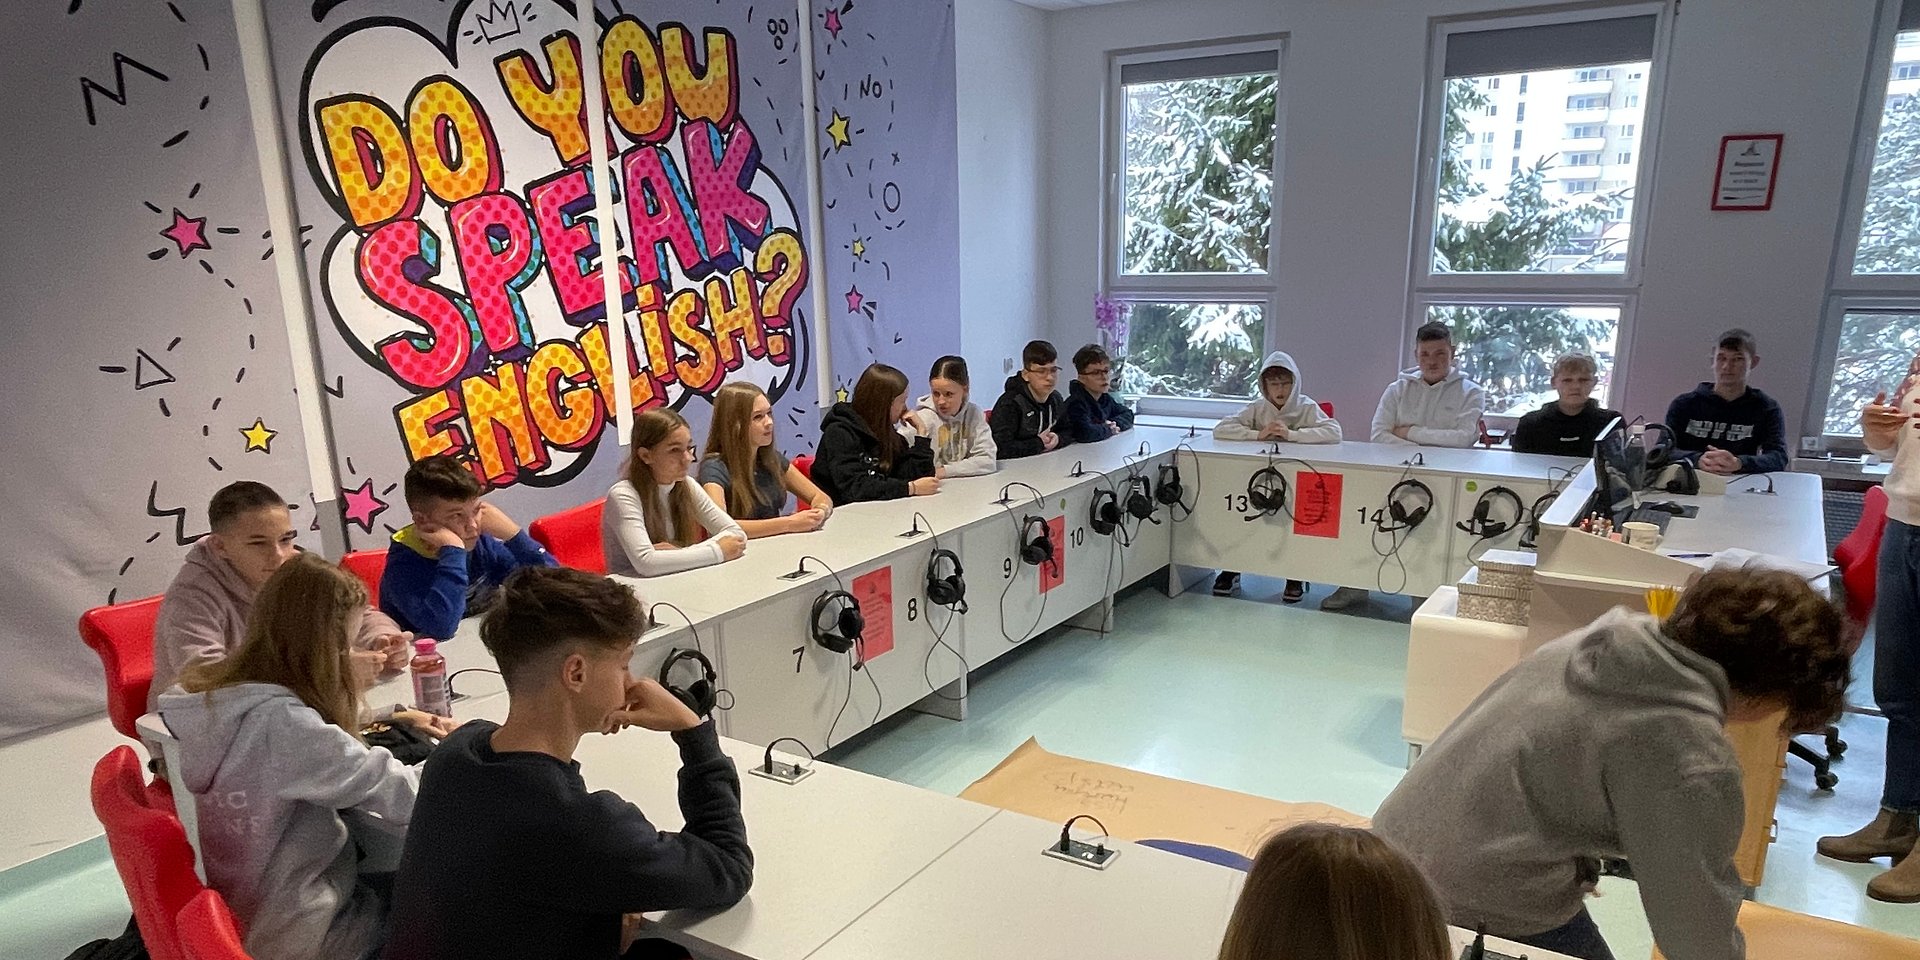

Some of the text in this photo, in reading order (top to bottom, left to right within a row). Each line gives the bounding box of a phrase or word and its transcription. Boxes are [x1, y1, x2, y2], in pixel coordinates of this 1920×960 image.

[860, 74, 882, 98] NO
[315, 15, 738, 232] DO YOU
[354, 118, 769, 392] SPEAK
[1224, 494, 1248, 512] 13
[1357, 506, 1384, 527] 14
[1070, 527, 1084, 549] 10
[1003, 558, 1012, 579] 9
[907, 598, 917, 621] 8
[793, 646, 805, 673] 7
